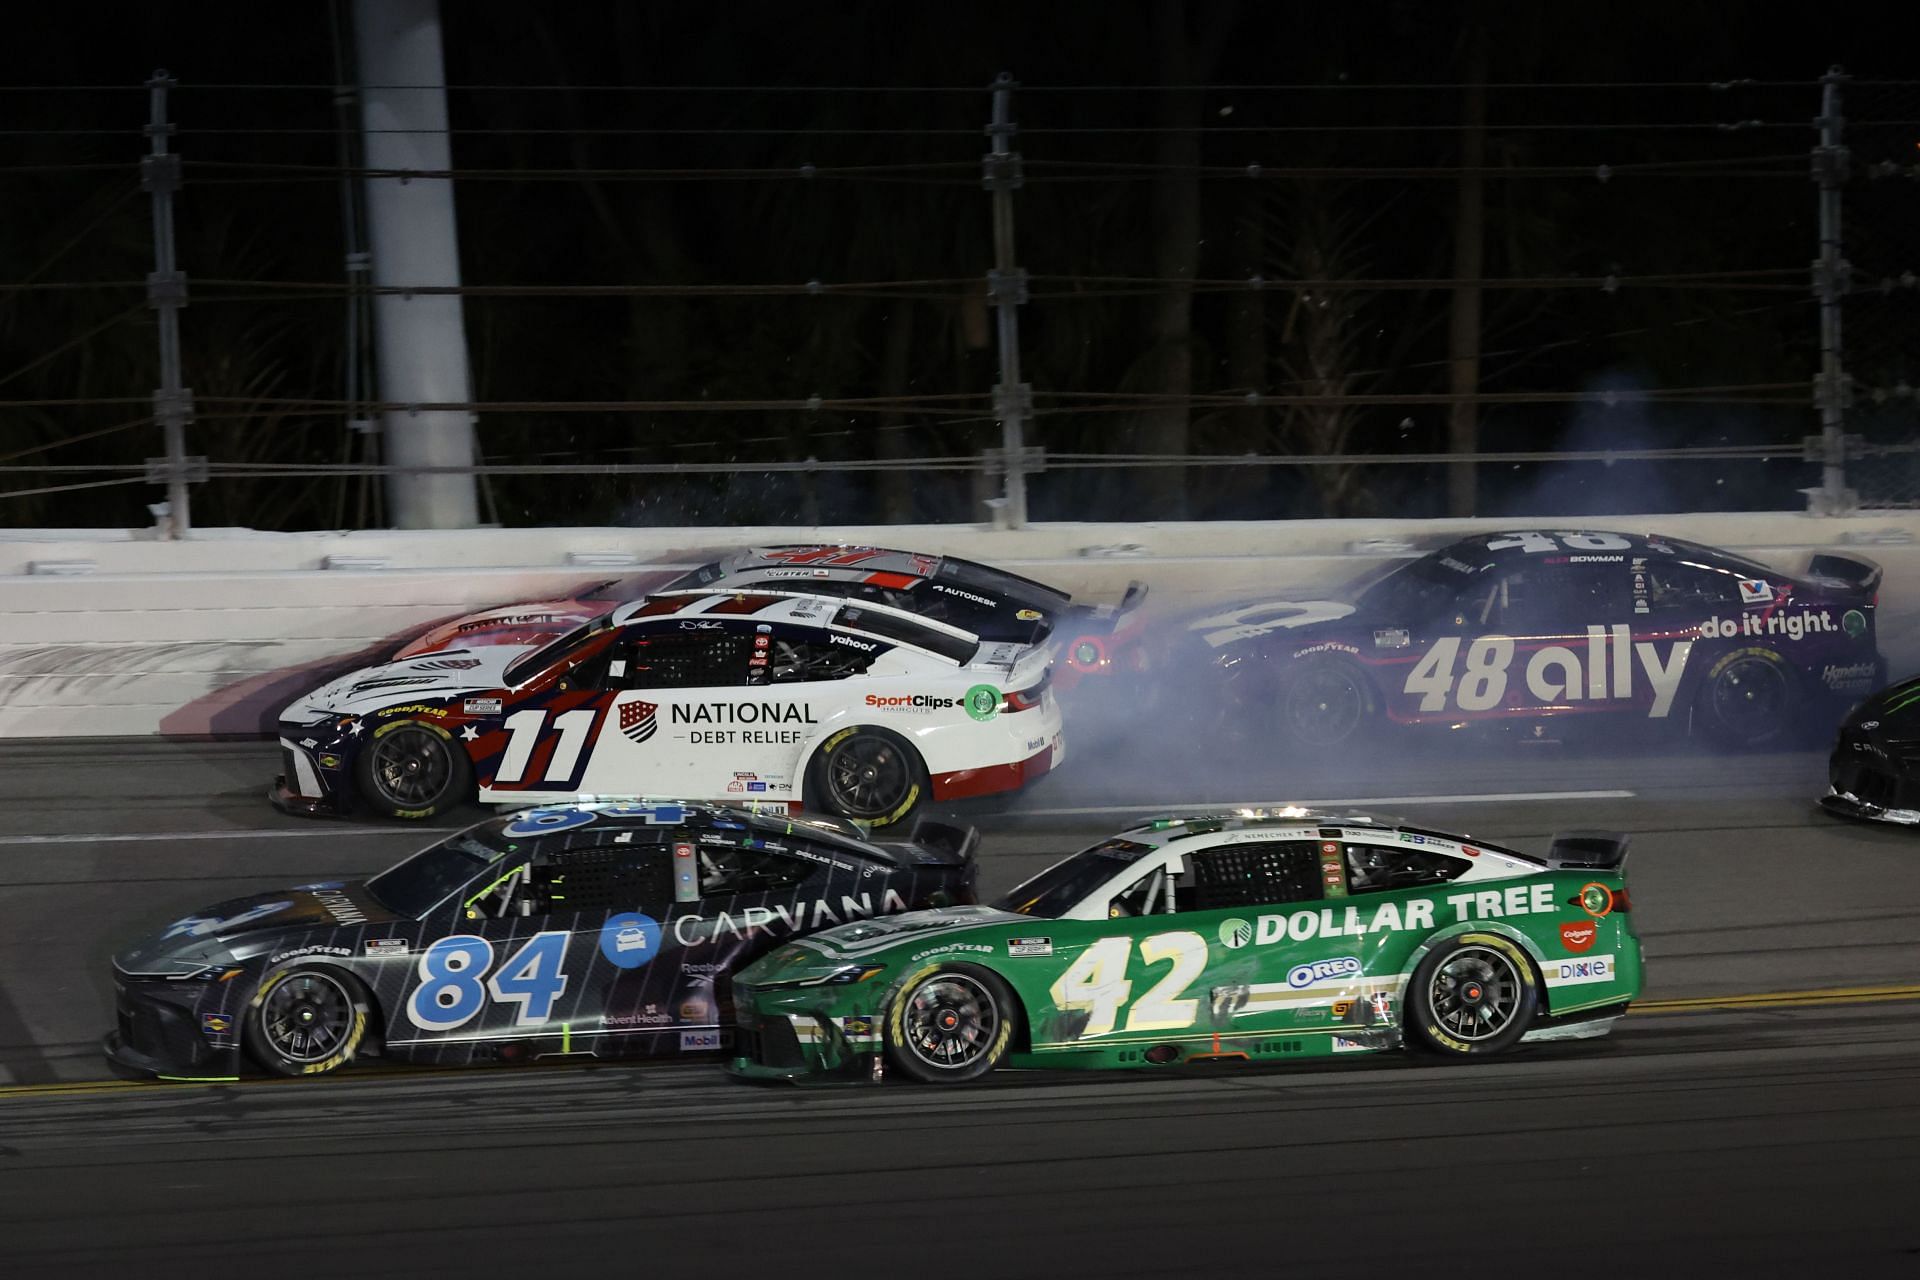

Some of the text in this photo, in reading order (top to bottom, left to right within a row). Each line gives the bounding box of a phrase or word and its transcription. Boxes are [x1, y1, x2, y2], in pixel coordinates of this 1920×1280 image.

[944, 586, 998, 608] AUTODESK
[1701, 610, 1839, 641] do it right.
[829, 633, 877, 651] yahoo!
[1293, 641, 1360, 659] GOODYEAR
[1403, 635, 1515, 712] 48
[1526, 624, 1694, 718] ally
[377, 704, 449, 718] GOODYEAR
[671, 702, 818, 724] NATIONAL
[881, 706, 933, 714] HAIRCUTS
[495, 709, 597, 783] 11
[690, 730, 801, 744] DEBT RELIEF
[795, 849, 831, 864] DOLLAR
[311, 890, 369, 927] CARVANA
[674, 888, 908, 947] CARVANA
[1254, 883, 1556, 946] DOLLAR TREE
[270, 944, 353, 963] GOODYEAR
[911, 942, 994, 962] GOODYEAR
[406, 931, 571, 1031] 84
[1049, 931, 1209, 1034] 42
[1288, 957, 1360, 989] OREO
[684, 1035, 718, 1046] Mobil
